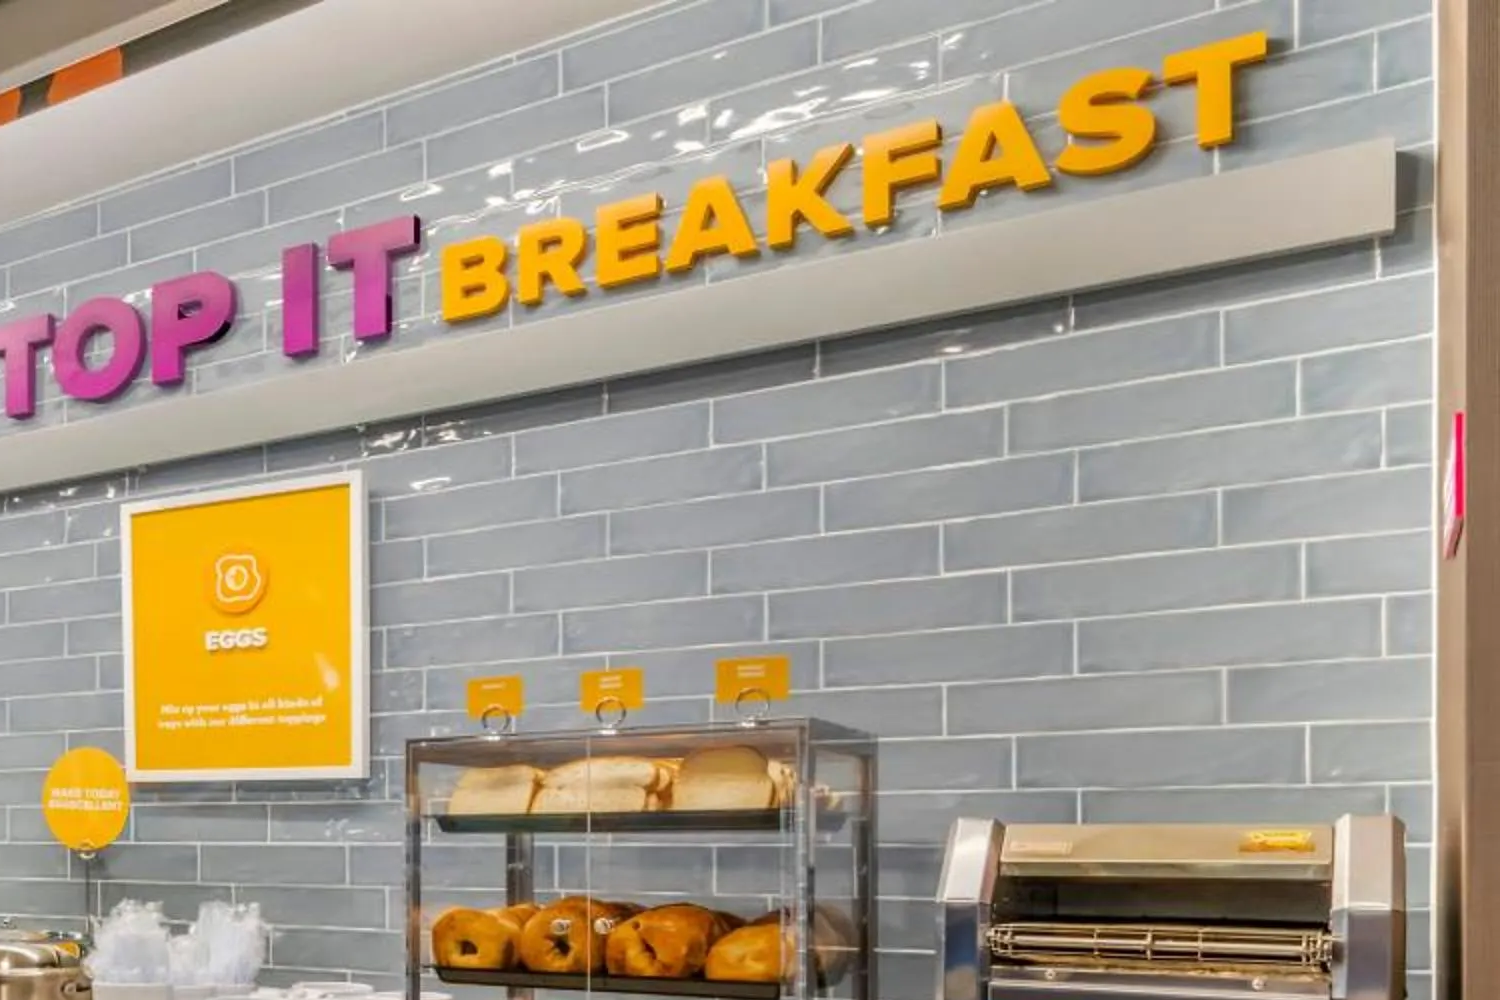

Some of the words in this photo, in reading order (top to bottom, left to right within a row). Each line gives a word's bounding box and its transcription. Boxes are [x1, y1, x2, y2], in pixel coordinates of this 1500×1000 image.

[283, 215, 420, 361] IT
[440, 31, 1270, 323] BREAKFAST
[205, 627, 269, 651] EGGS
